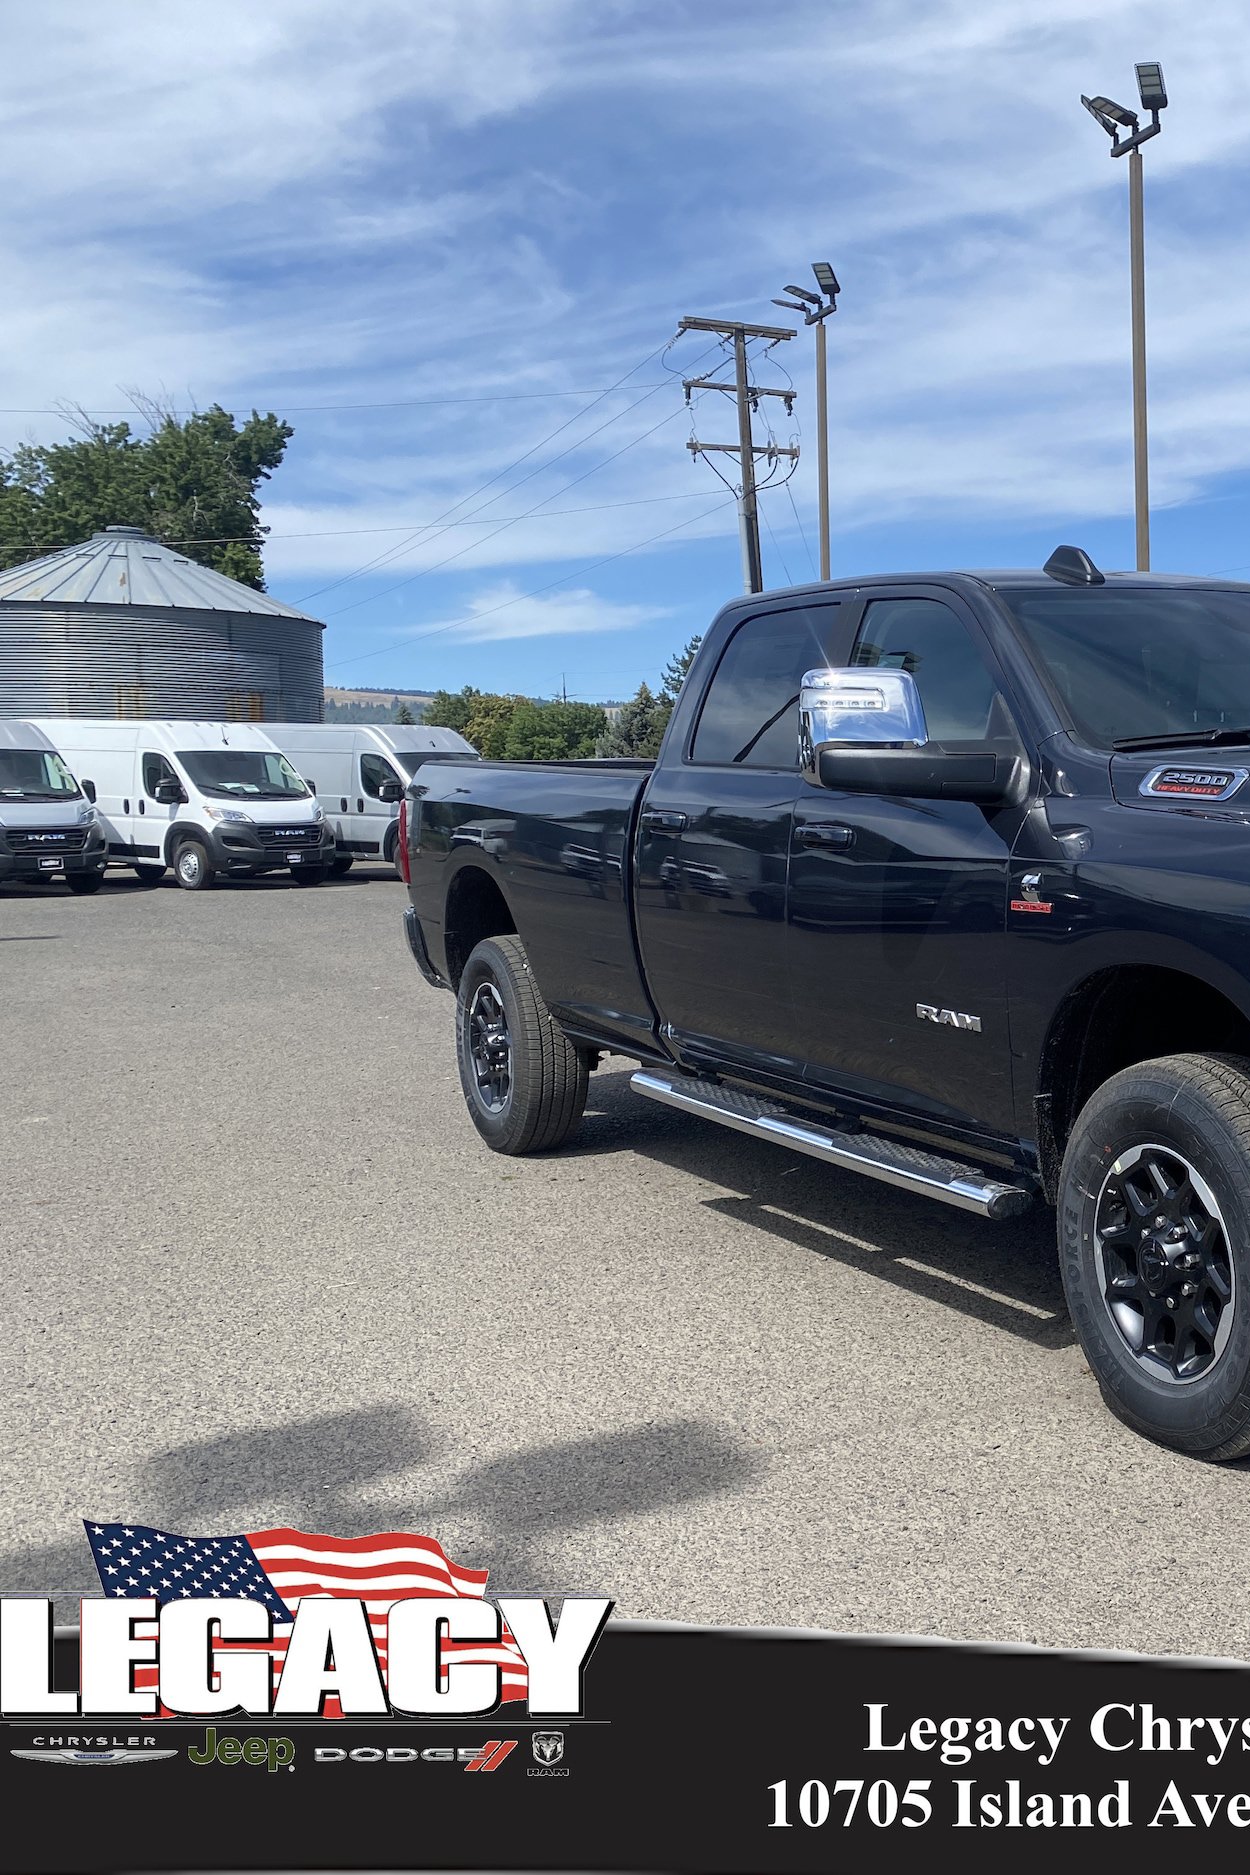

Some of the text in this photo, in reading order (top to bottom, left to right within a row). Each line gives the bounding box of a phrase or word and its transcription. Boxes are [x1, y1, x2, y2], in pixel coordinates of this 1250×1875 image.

[1163, 772, 1228, 786] 2500
[1156, 784, 1221, 795] HEAVY DUTY
[916, 1003, 982, 1033] RAM
